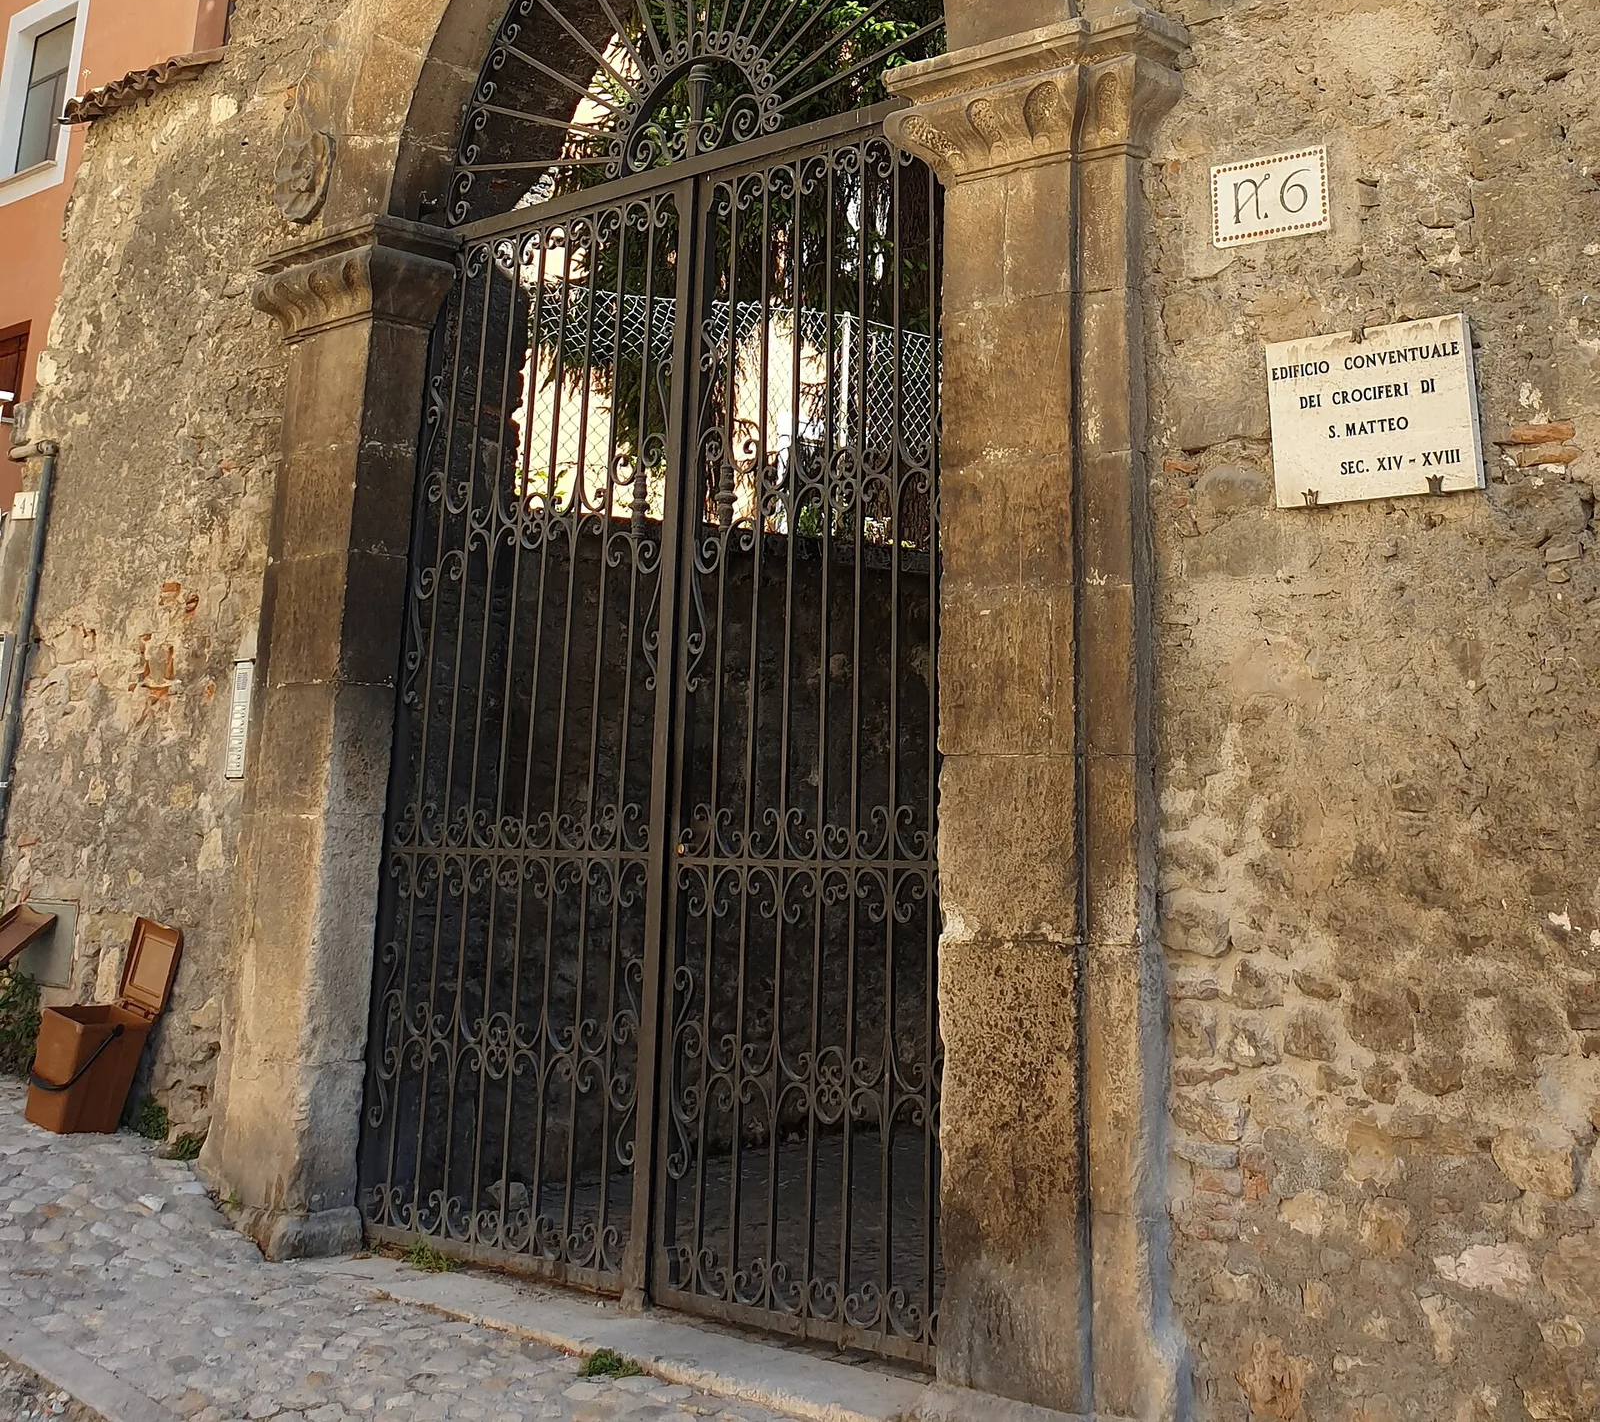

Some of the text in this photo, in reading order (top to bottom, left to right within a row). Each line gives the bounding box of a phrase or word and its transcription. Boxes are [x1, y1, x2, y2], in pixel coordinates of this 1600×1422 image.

[1280, 168, 1310, 213] 6
[1271, 341, 1460, 381] EDIFICIO CONVENTUALE
[1300, 378, 1436, 409] DEI CROCIFERI DI
[1328, 416, 1409, 439] S. MATTEO
[1340, 460, 1370, 475] SEC.
[1377, 455, 1403, 472] XIV
[1422, 448, 1461, 467] XVIII
[20, 497, 26, 514] 4
